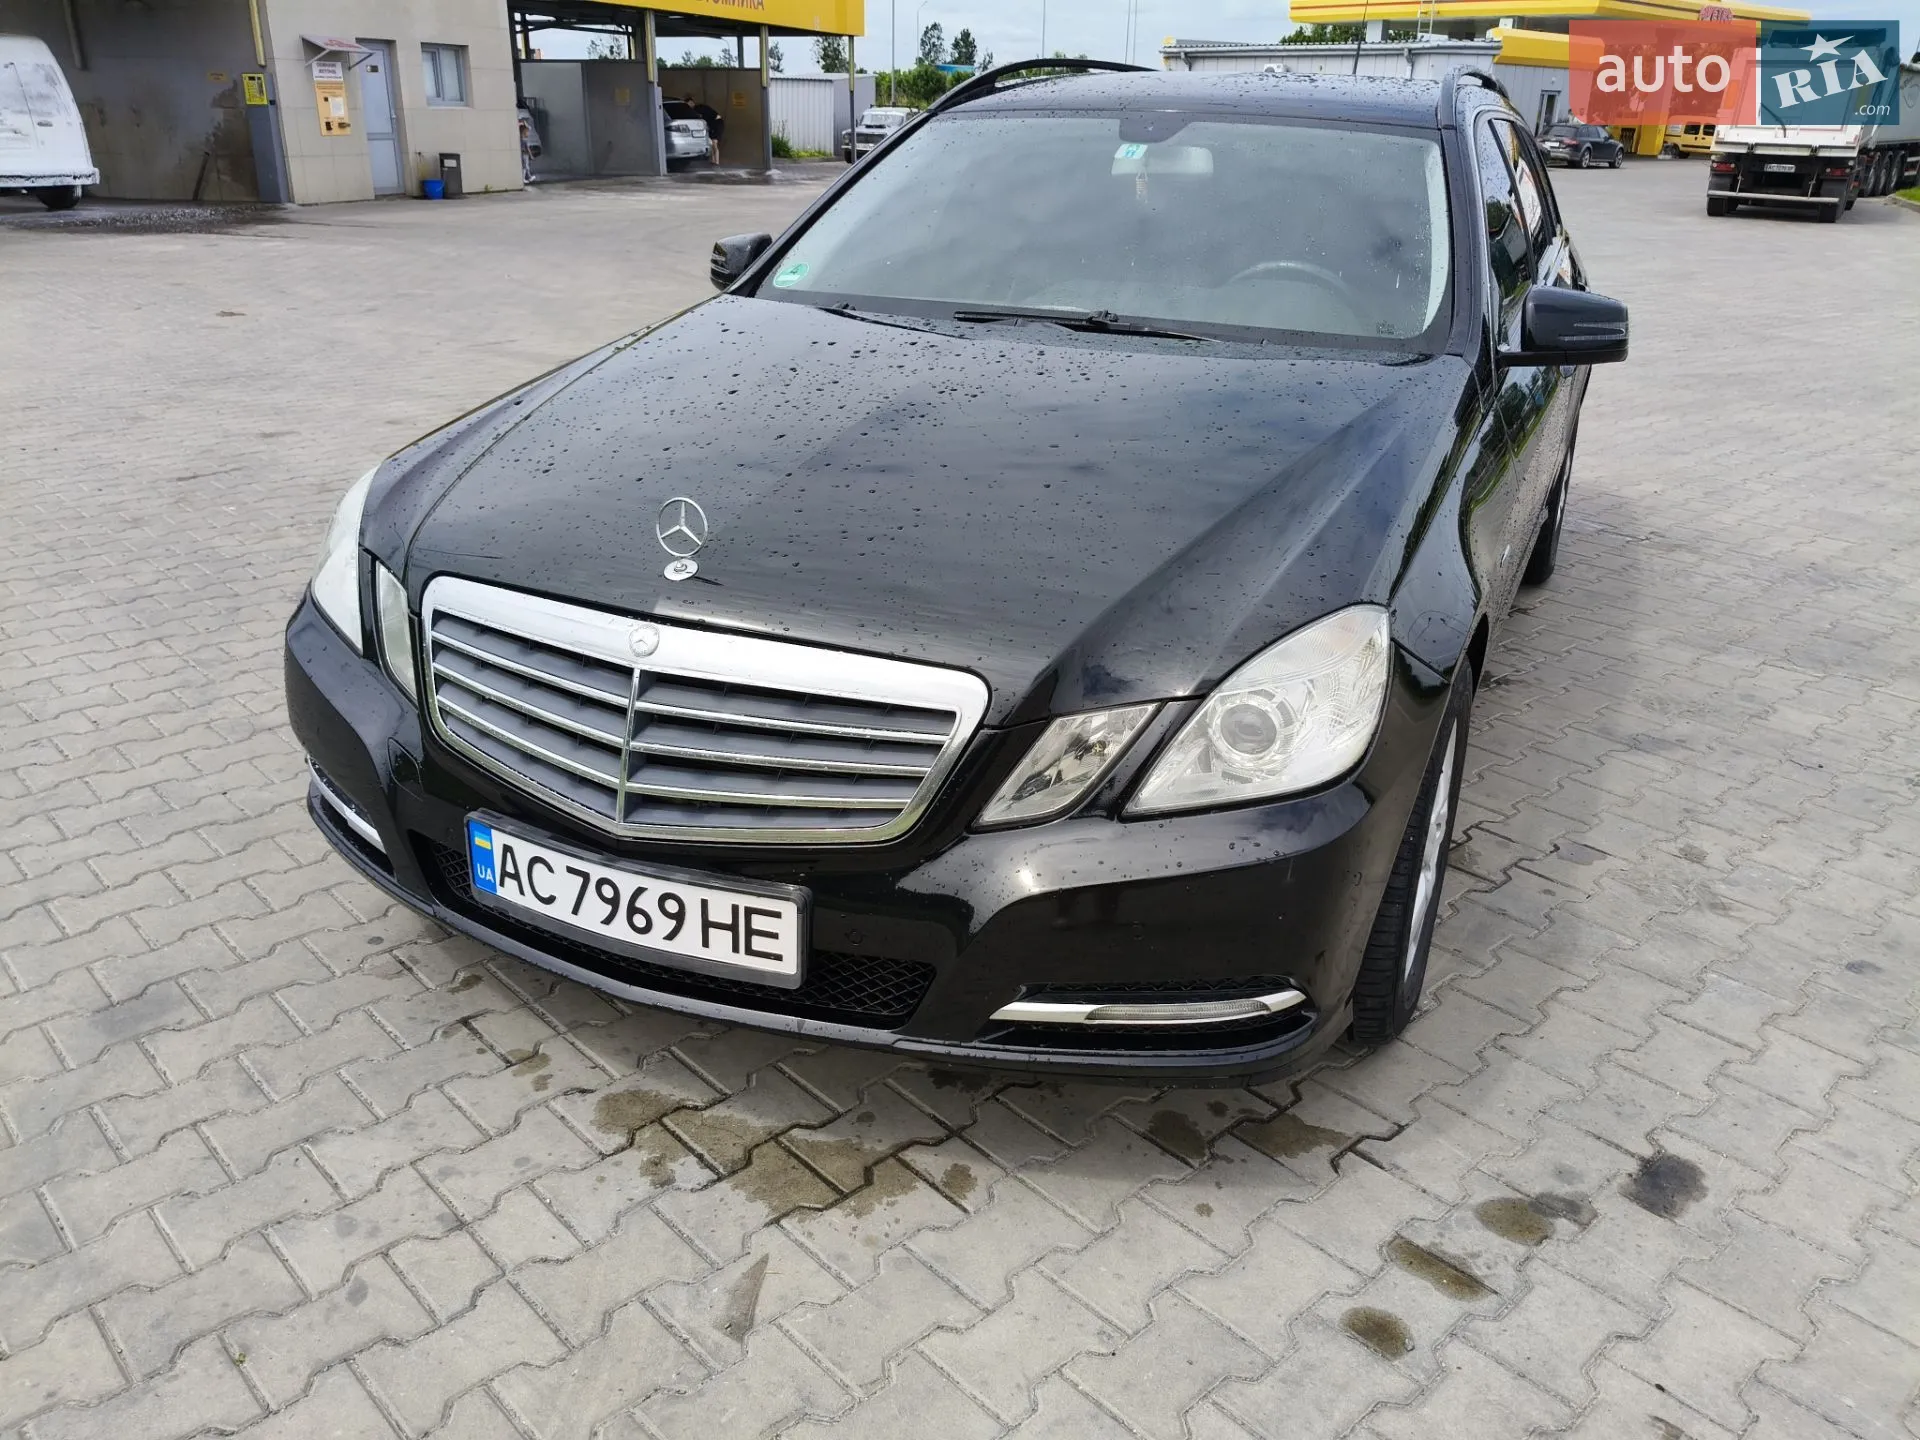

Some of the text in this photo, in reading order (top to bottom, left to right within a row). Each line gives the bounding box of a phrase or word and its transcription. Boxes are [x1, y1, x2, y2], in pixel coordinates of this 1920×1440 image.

[477, 862, 495, 883] UA
[499, 843, 783, 962] AC 7969 HE
